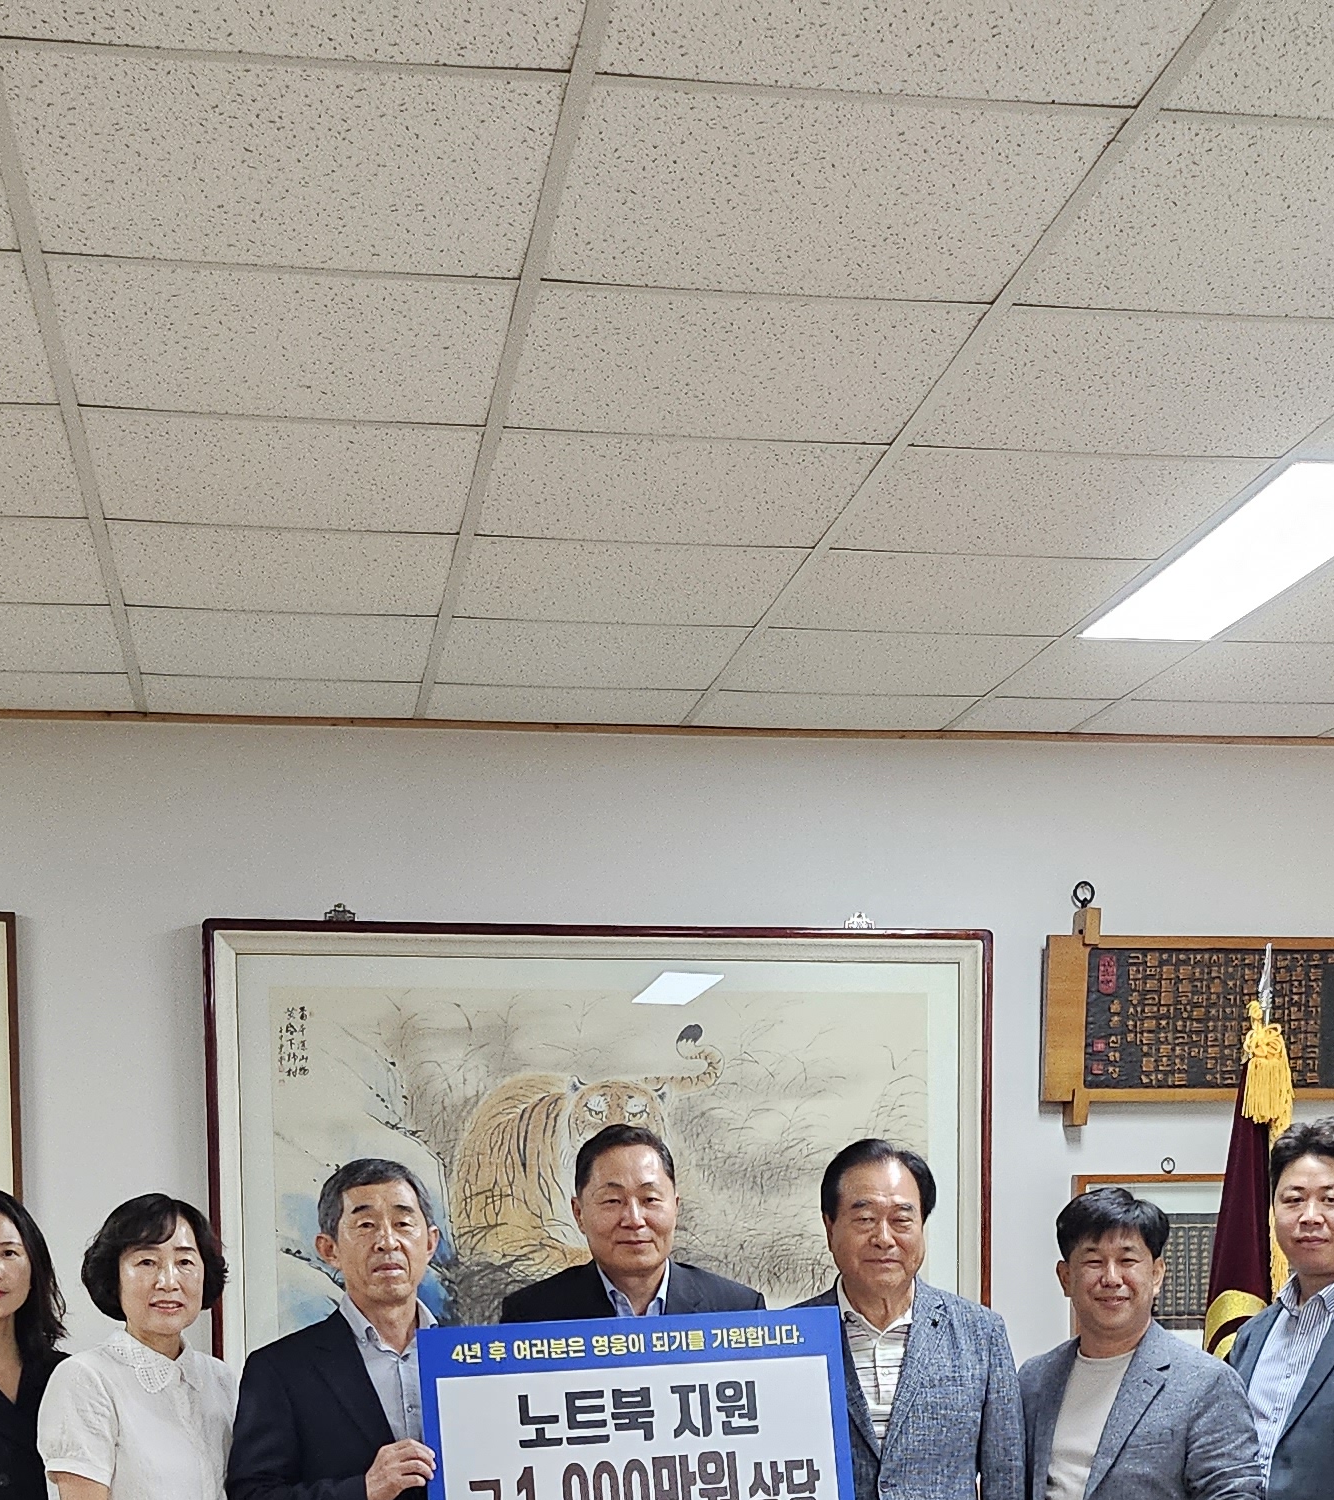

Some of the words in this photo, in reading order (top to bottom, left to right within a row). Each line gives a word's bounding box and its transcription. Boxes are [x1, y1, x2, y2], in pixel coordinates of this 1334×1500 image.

[451, 1341, 483, 1364] 4년
[488, 1340, 507, 1361] 후
[513, 1336, 586, 1360] 여러분은
[591, 1333, 646, 1356] 영웅이
[651, 1330, 705, 1353] 되기를
[710, 1324, 805, 1349] 기원합니다.
[517, 1386, 655, 1449] 노트북
[669, 1380, 760, 1440] 지원
